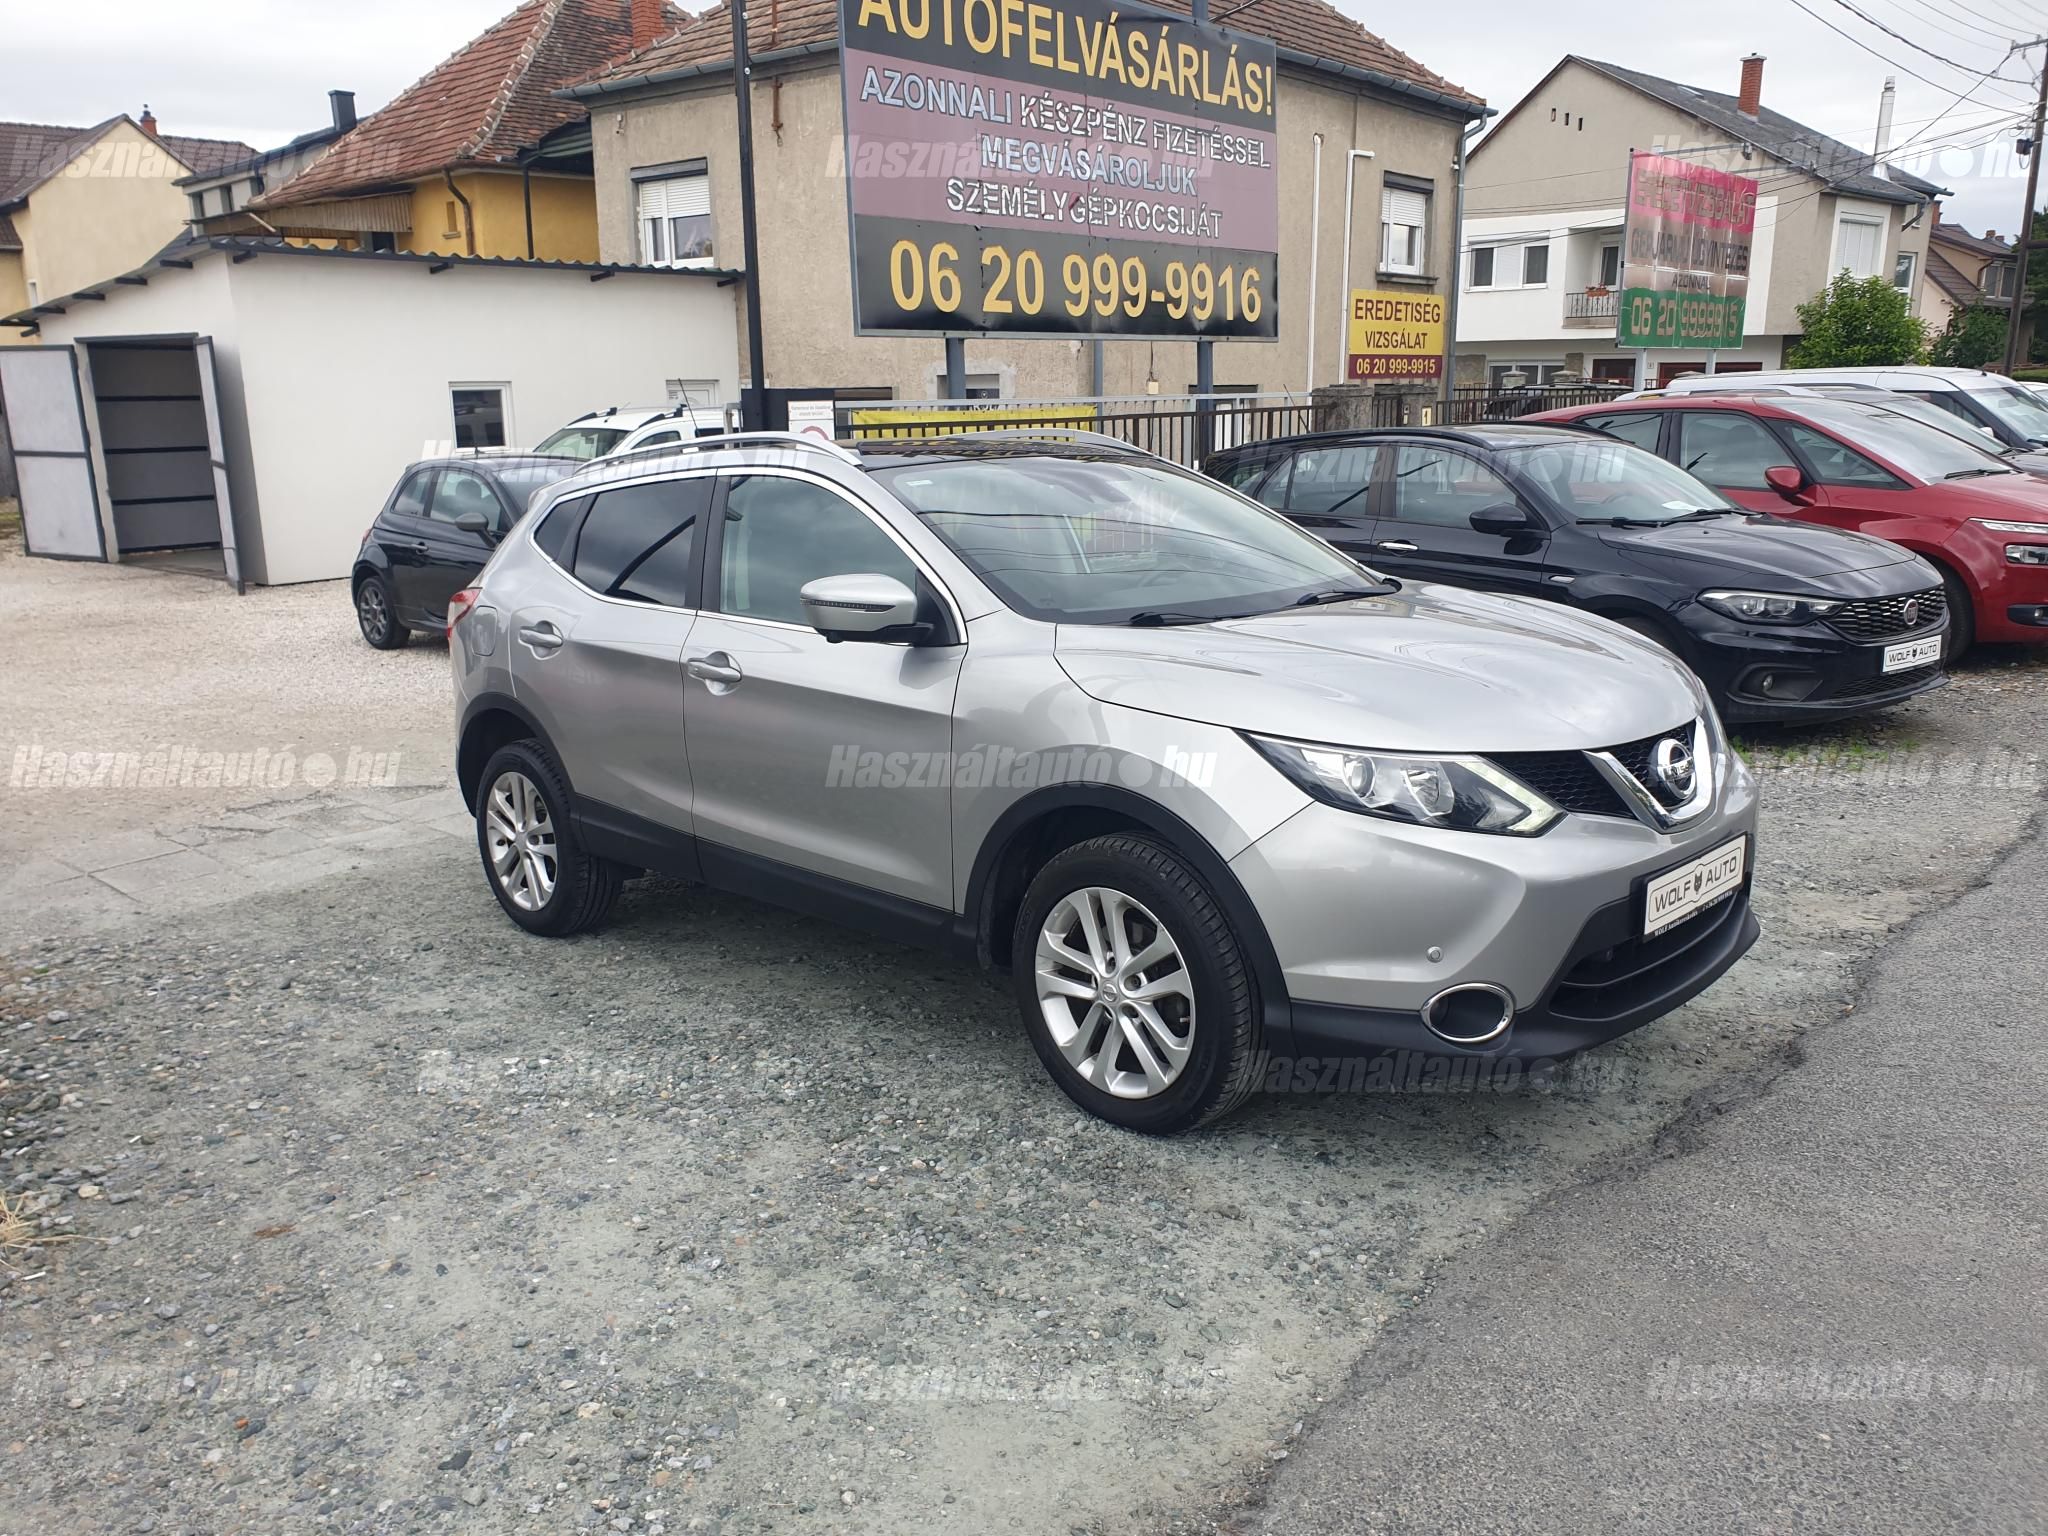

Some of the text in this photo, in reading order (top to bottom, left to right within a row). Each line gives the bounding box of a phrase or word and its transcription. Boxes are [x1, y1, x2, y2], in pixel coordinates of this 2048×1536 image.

[861, 66, 1271, 168] AZONNALI KÉSZPÉNZ FIZETÉSSEL
[981, 133, 1198, 197] MEGVÁSÁROLJUK
[946, 178, 1223, 239] SZEMÉLYGÉPKOCSIJÁT
[890, 239, 1262, 322] 06 20 999-9916
[1354, 297, 1441, 323] EREDETISÉG
[1631, 296, 1652, 336] 06
[1656, 298, 1677, 336] 20
[1365, 328, 1428, 349] VIZSGÁLAT
[1356, 358, 1436, 375] 06 20 999-9915
[1888, 644, 1937, 663] WOLF AUTO
[1654, 856, 1737, 913] WOLF AUTO
